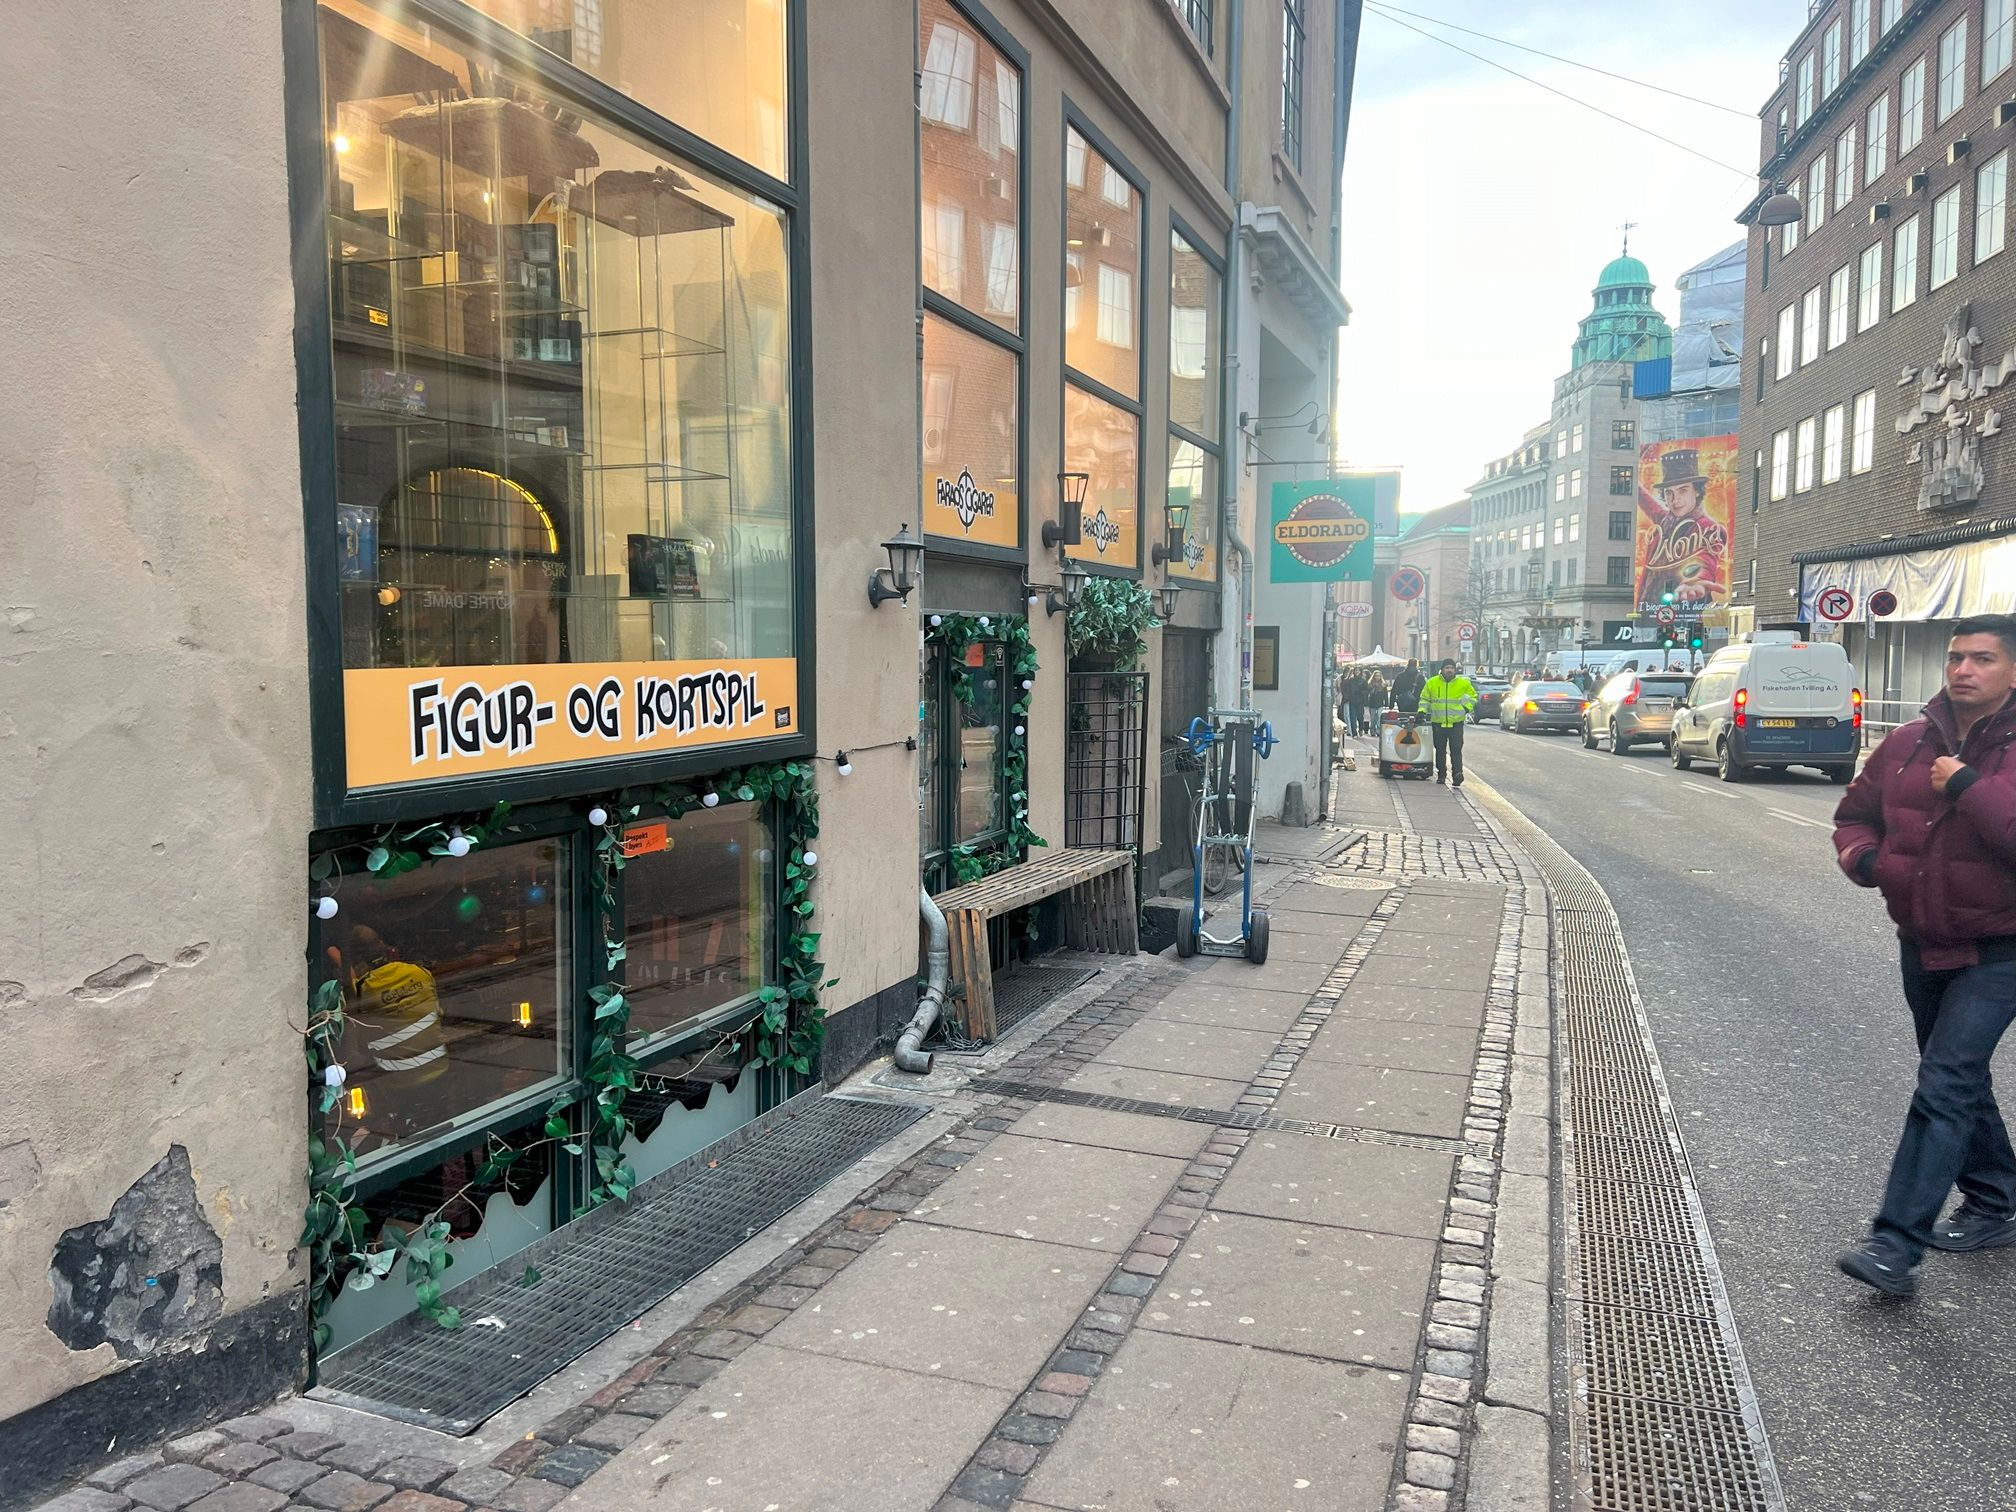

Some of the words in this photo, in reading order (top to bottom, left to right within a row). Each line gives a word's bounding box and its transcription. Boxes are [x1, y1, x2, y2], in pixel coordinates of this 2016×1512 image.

[937, 478, 964, 509] FARAOS
[965, 487, 995, 517] CIGARER
[1278, 523, 1366, 539] ELDORADO
[1645, 519, 1728, 566] Wonka
[1614, 626, 1633, 640] JD
[411, 679, 556, 763] FIGUR-
[567, 680, 624, 740] OG
[635, 671, 765, 742] KORTSPIL
[381, 979, 424, 1004] Carlsberg
